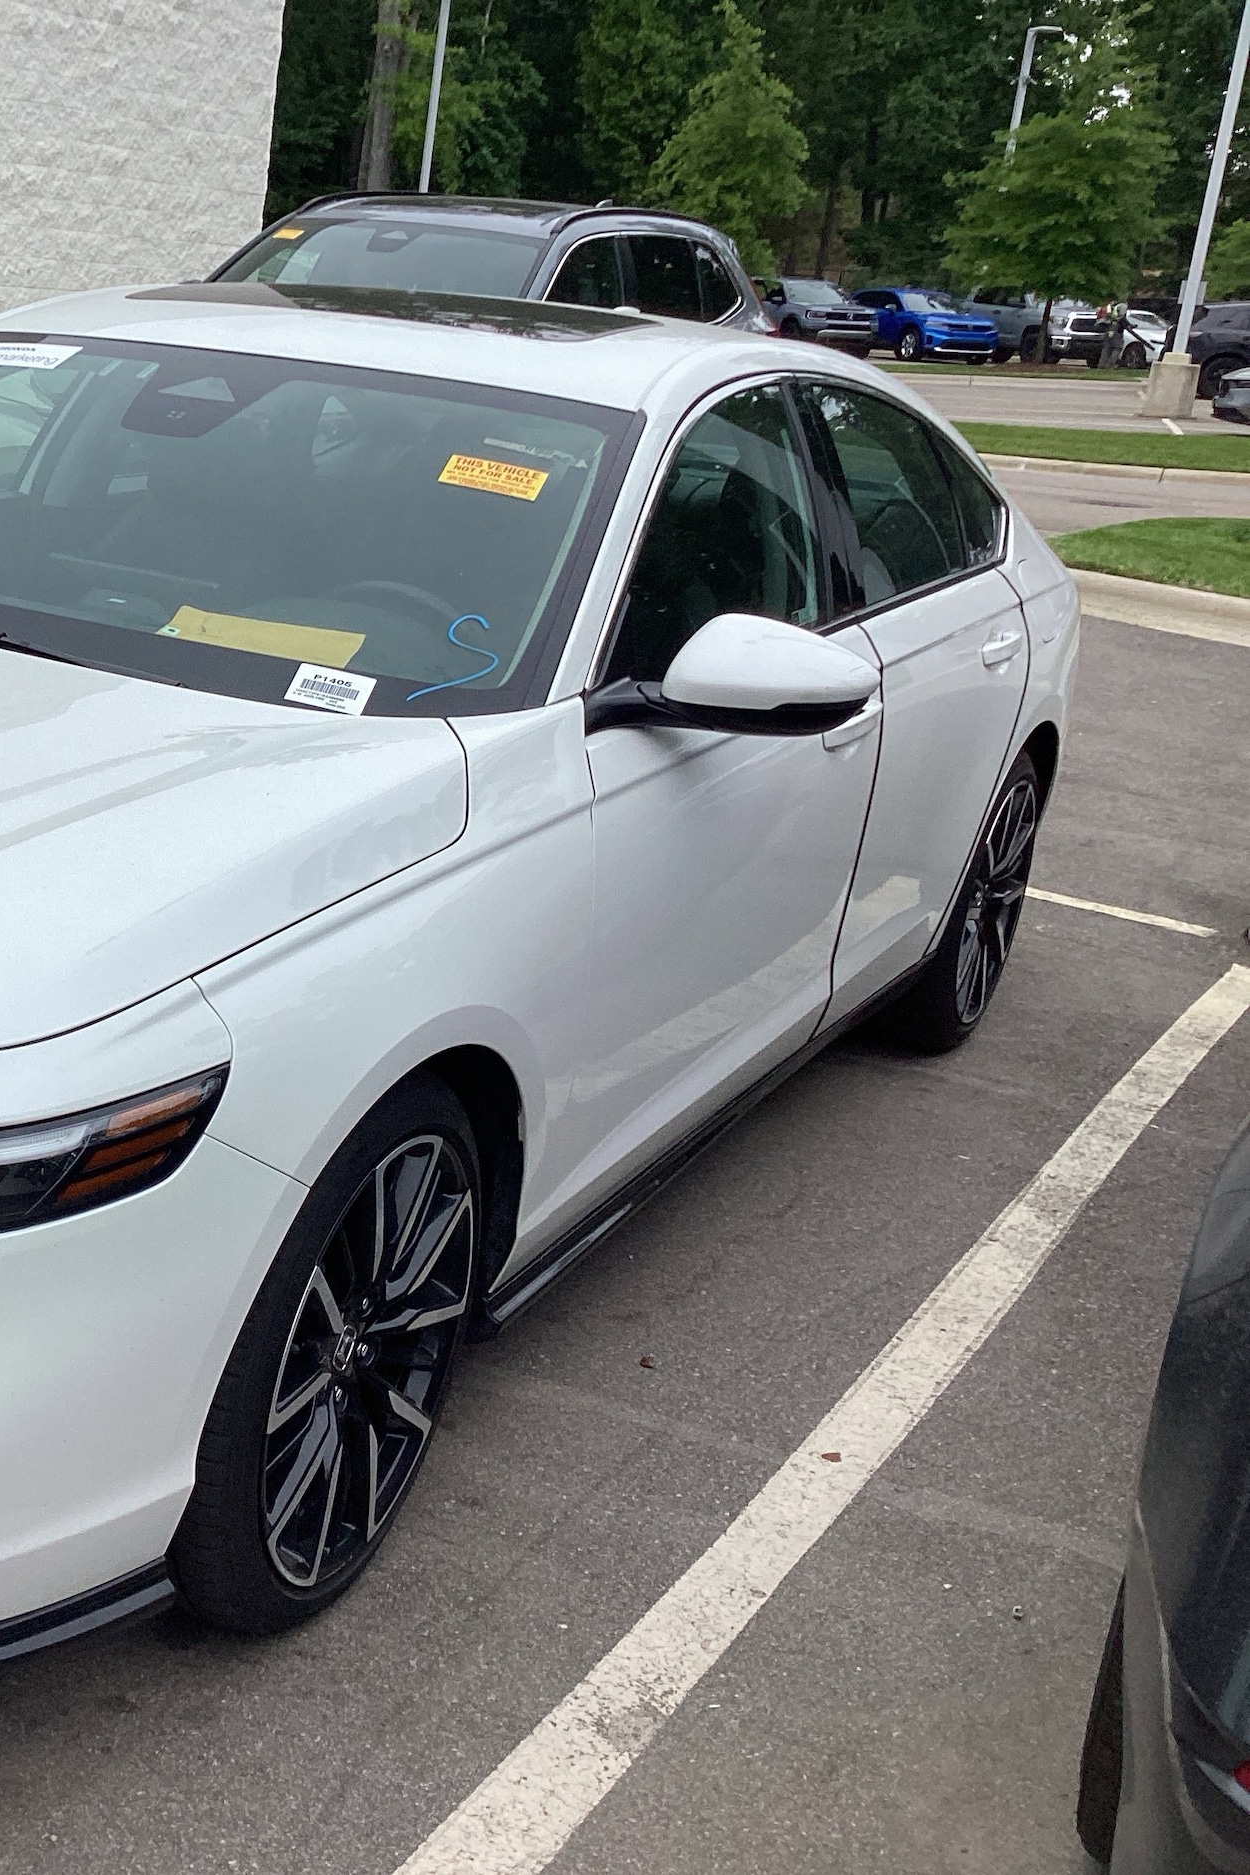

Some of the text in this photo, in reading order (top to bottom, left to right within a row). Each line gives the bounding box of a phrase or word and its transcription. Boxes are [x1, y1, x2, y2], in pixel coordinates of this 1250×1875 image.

[453, 464, 477, 473] NOT
[479, 469, 503, 479] FOR
[505, 474, 535, 486] SALE
[455, 457, 541, 480] THIS VEHICLE
